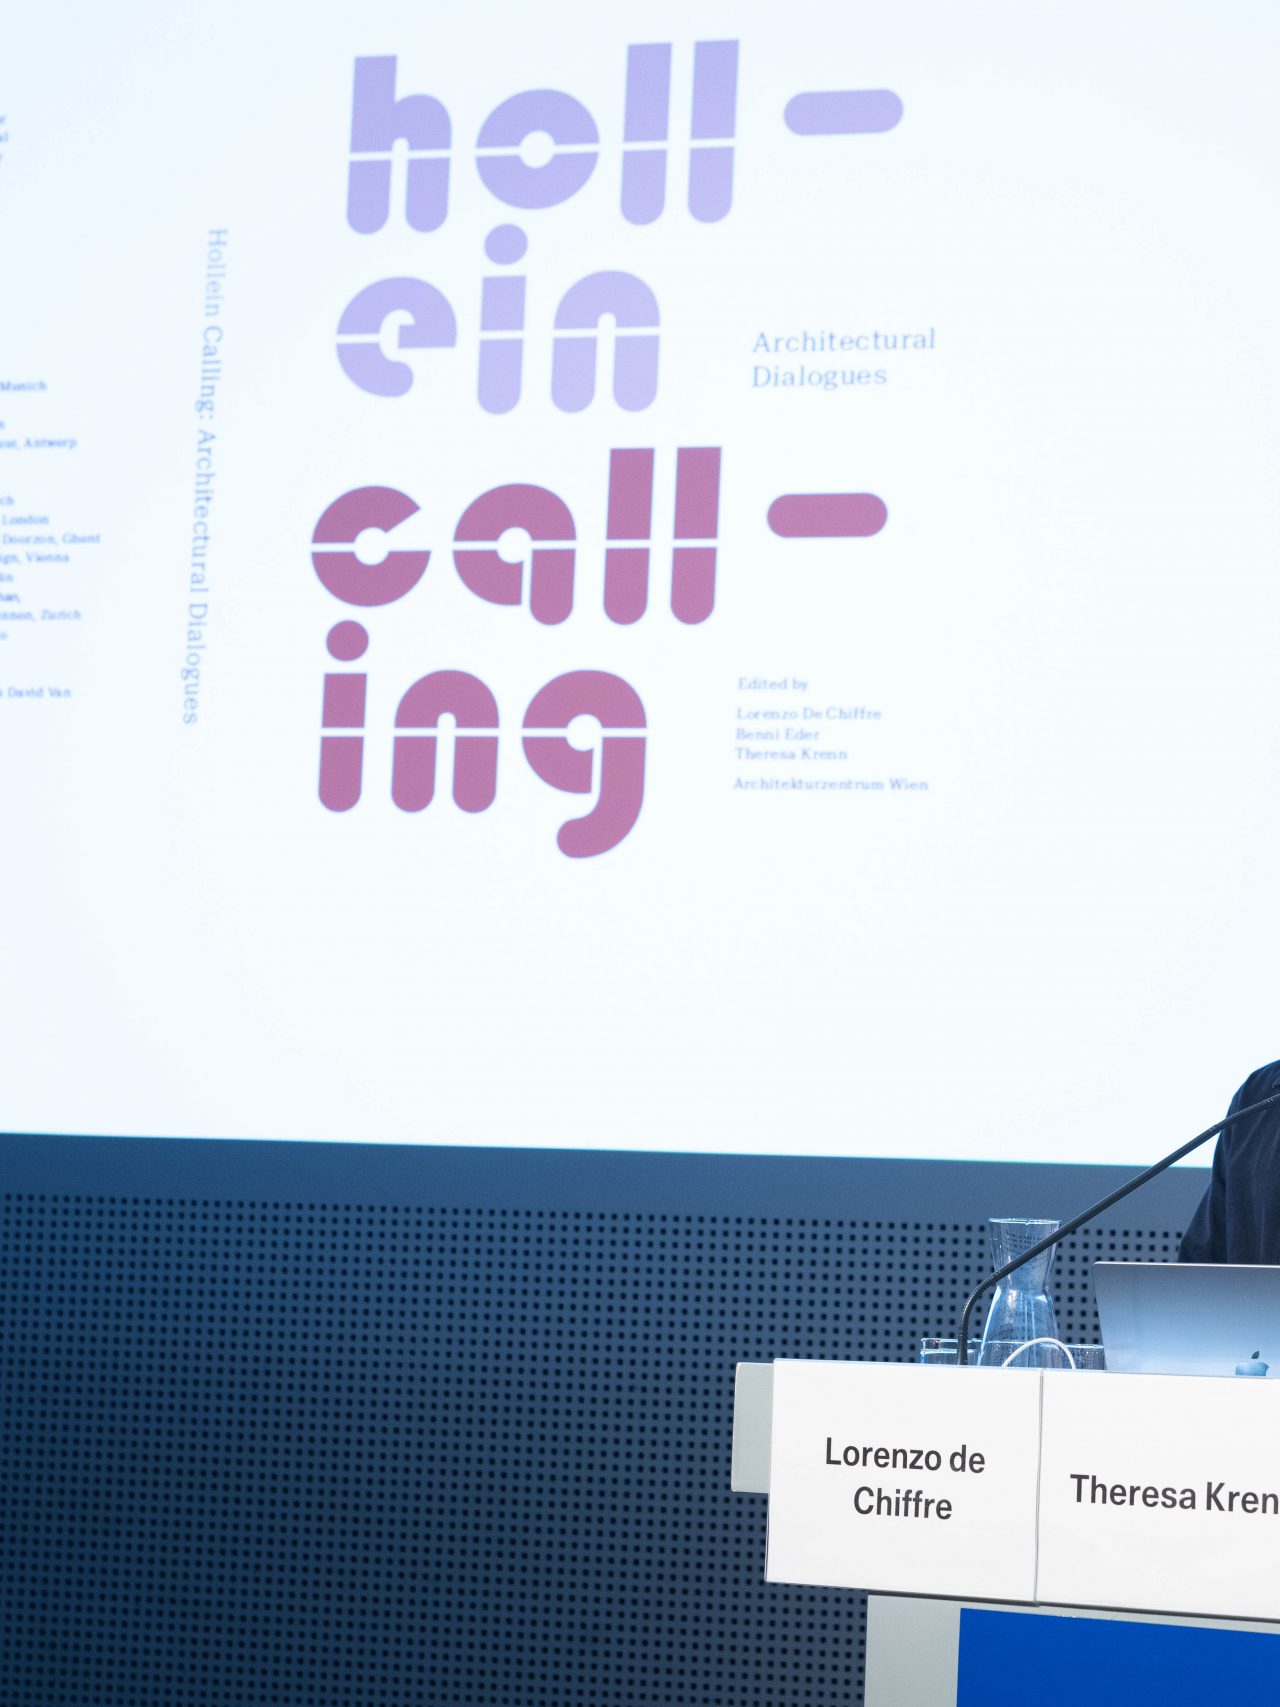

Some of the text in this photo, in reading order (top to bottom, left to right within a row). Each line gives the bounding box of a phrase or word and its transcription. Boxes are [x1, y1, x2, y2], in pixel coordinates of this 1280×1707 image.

[346, 39, 904, 235] holl-
[335, 223, 661, 415] ein
[752, 327, 935, 353] Architectural
[752, 365, 887, 390] Dialogues
[180, 228, 229, 724] Hollein Calling: Architectural Dialogues
[311, 446, 889, 626] call-
[738, 677, 808, 693] Edited by
[736, 706, 882, 720] Lorenzo De Chiffre
[317, 620, 648, 859] ing
[736, 727, 820, 741] Benni Eder
[736, 747, 848, 760] Theresa Krenn
[734, 777, 929, 790] Architekturzentrum Wien
[825, 1437, 986, 1473] Lorenzo de
[853, 1486, 953, 1520] Chiffre
[1070, 1474, 1197, 1510] Theresa
